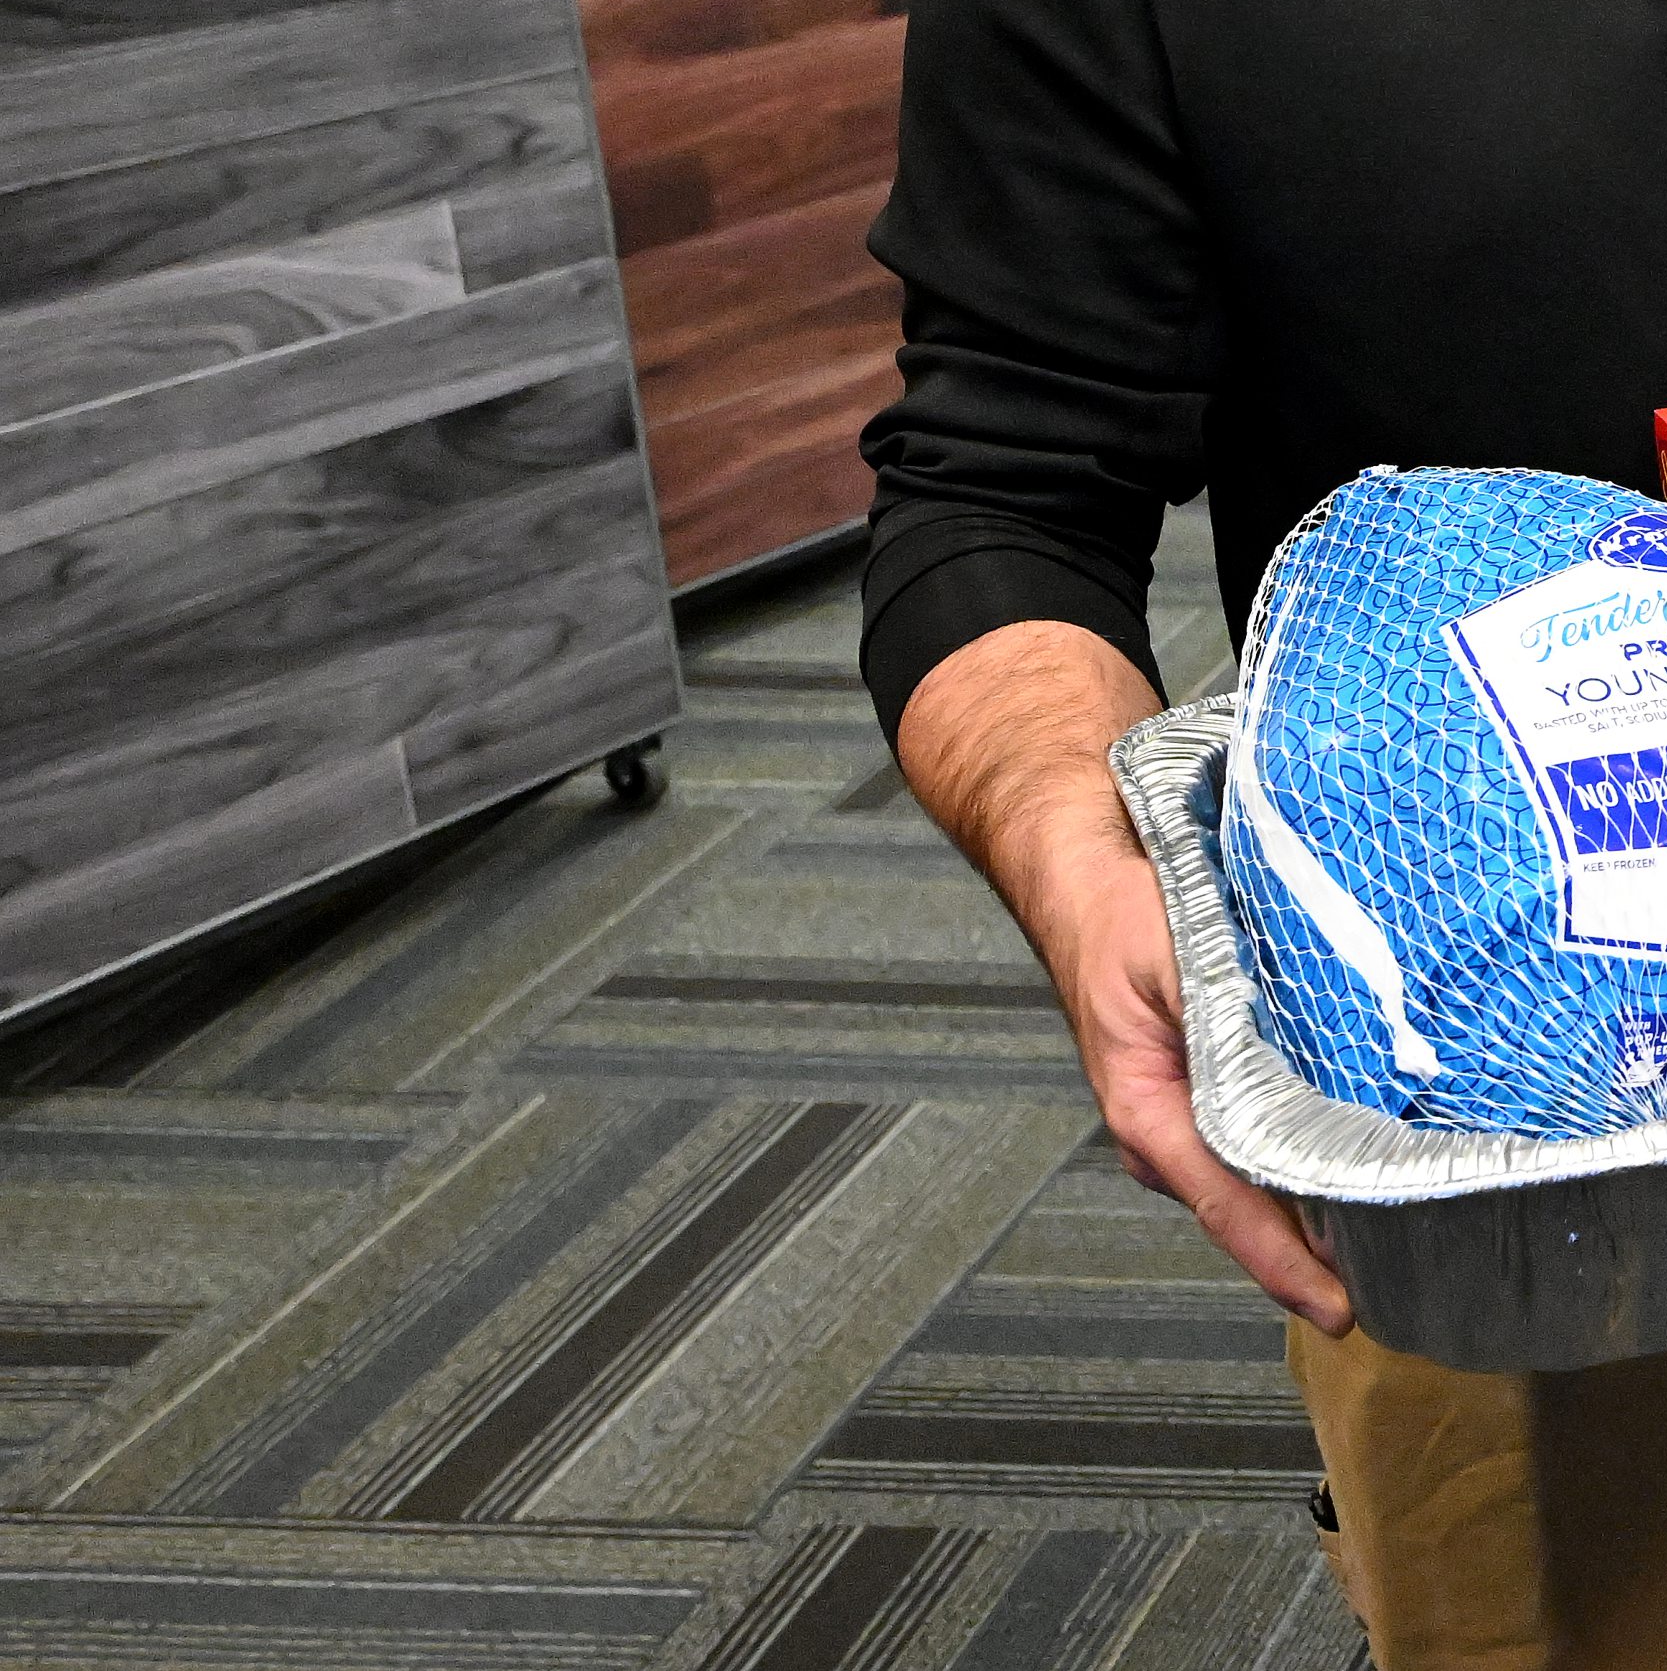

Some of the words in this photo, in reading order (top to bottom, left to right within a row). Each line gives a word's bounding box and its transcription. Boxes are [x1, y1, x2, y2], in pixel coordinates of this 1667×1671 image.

[1590, 705, 1628, 718] WITH
[1576, 780, 1618, 811] NO
[1612, 857, 1657, 871] FROZEN
